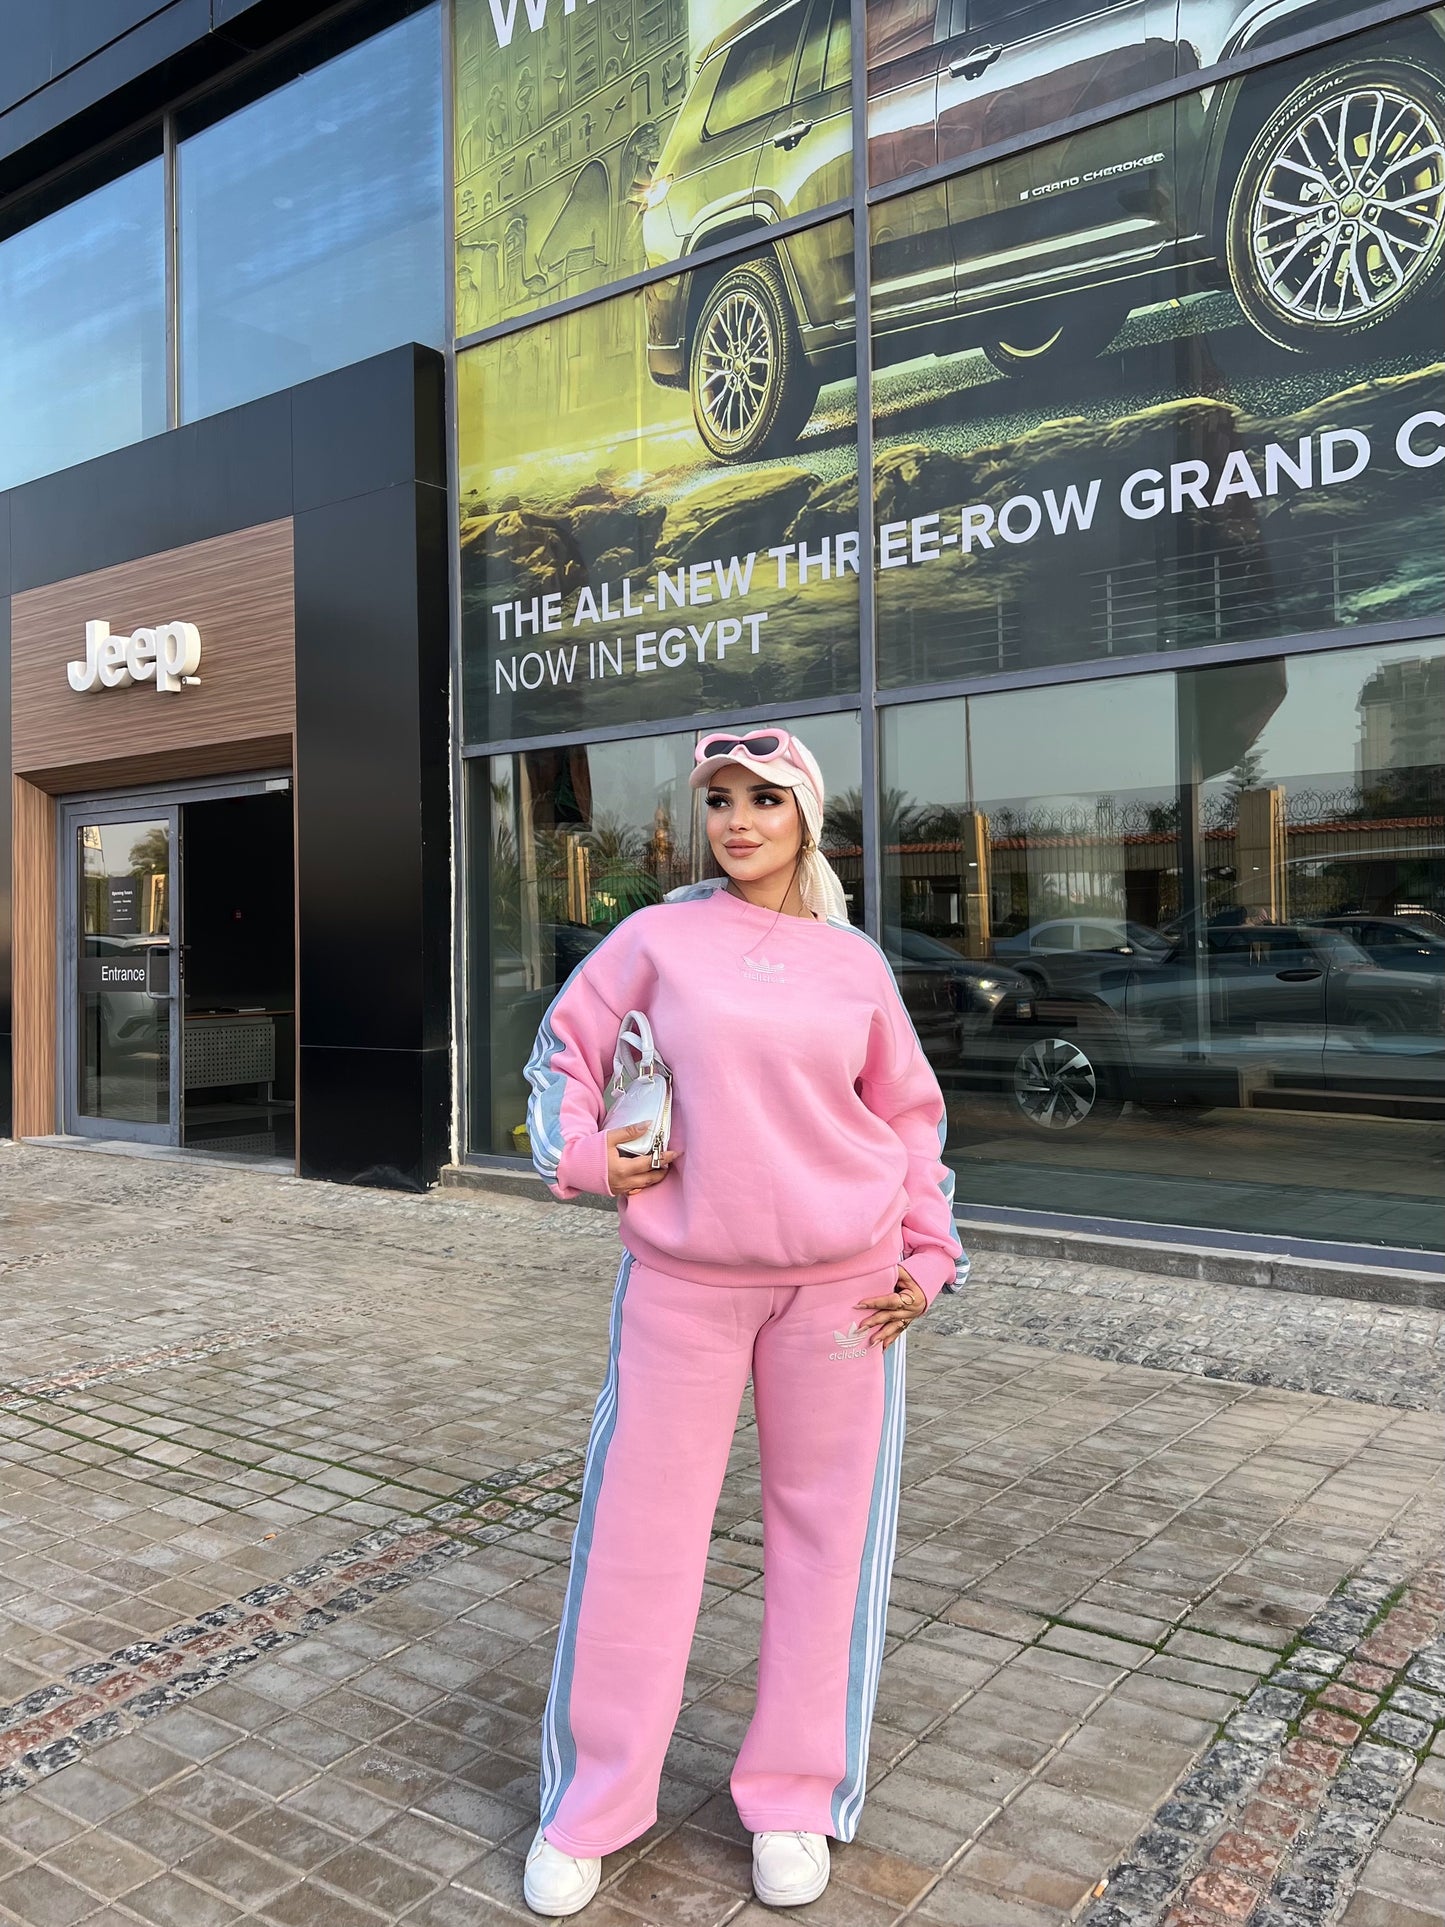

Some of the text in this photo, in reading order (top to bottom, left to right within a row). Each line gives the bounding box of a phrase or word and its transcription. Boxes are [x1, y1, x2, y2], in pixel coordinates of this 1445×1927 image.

[1031, 152, 1165, 197] GRAND CHEROKEE
[492, 591, 563, 640] THE
[573, 552, 756, 627] ALL-NEW
[1119, 428, 1371, 520] GRAND
[67, 620, 201, 692] Jeep
[495, 612, 768, 694] NOW IN EGYPT
[101, 966, 145, 981] Entrance
